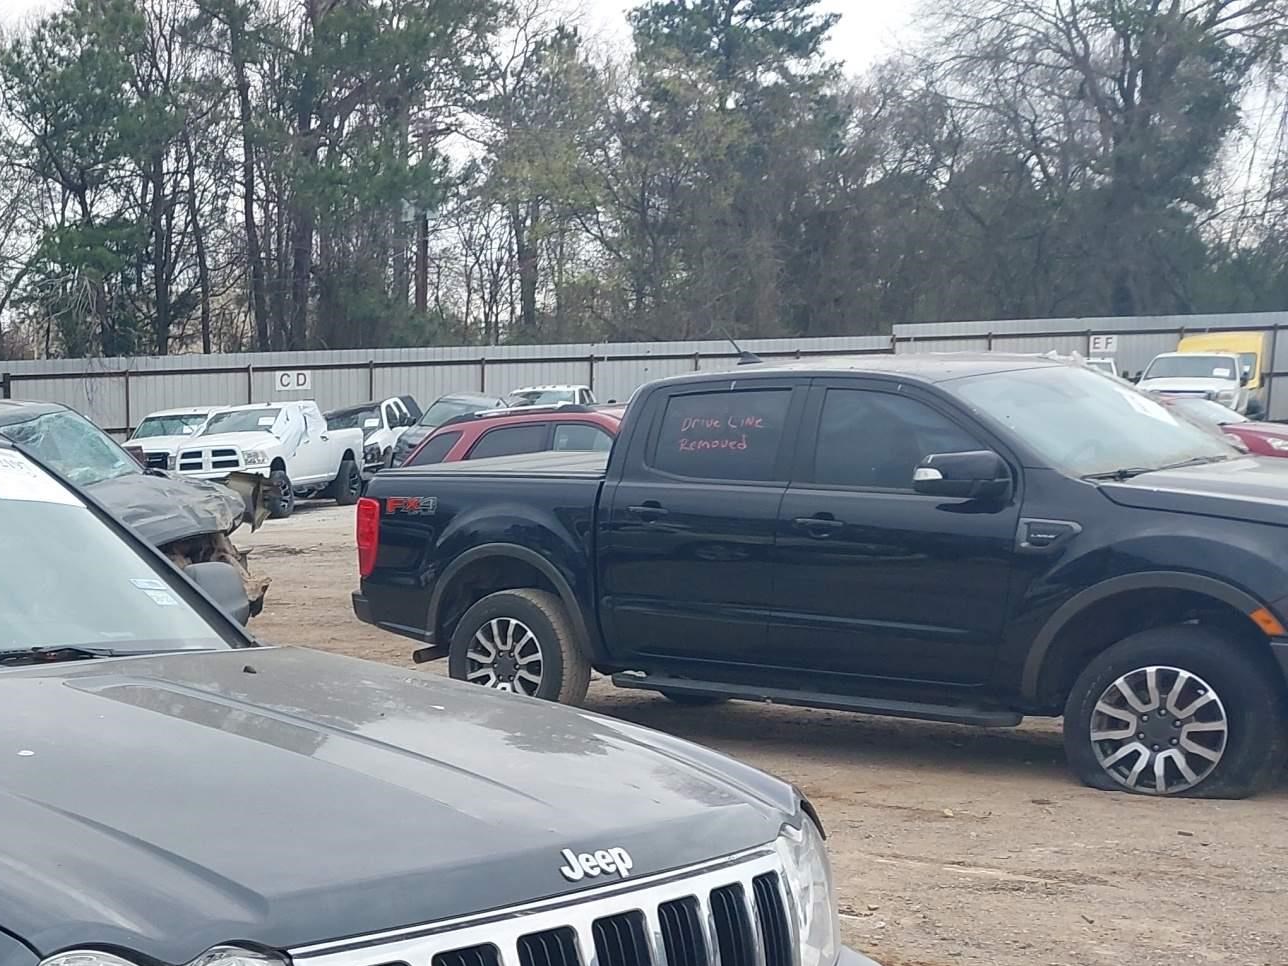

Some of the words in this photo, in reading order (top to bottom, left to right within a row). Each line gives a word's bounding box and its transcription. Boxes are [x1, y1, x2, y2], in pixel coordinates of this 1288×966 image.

[279, 372, 291, 388] C
[296, 372, 307, 387] D
[384, 496, 438, 515] FX4
[559, 847, 634, 882] Jeep
